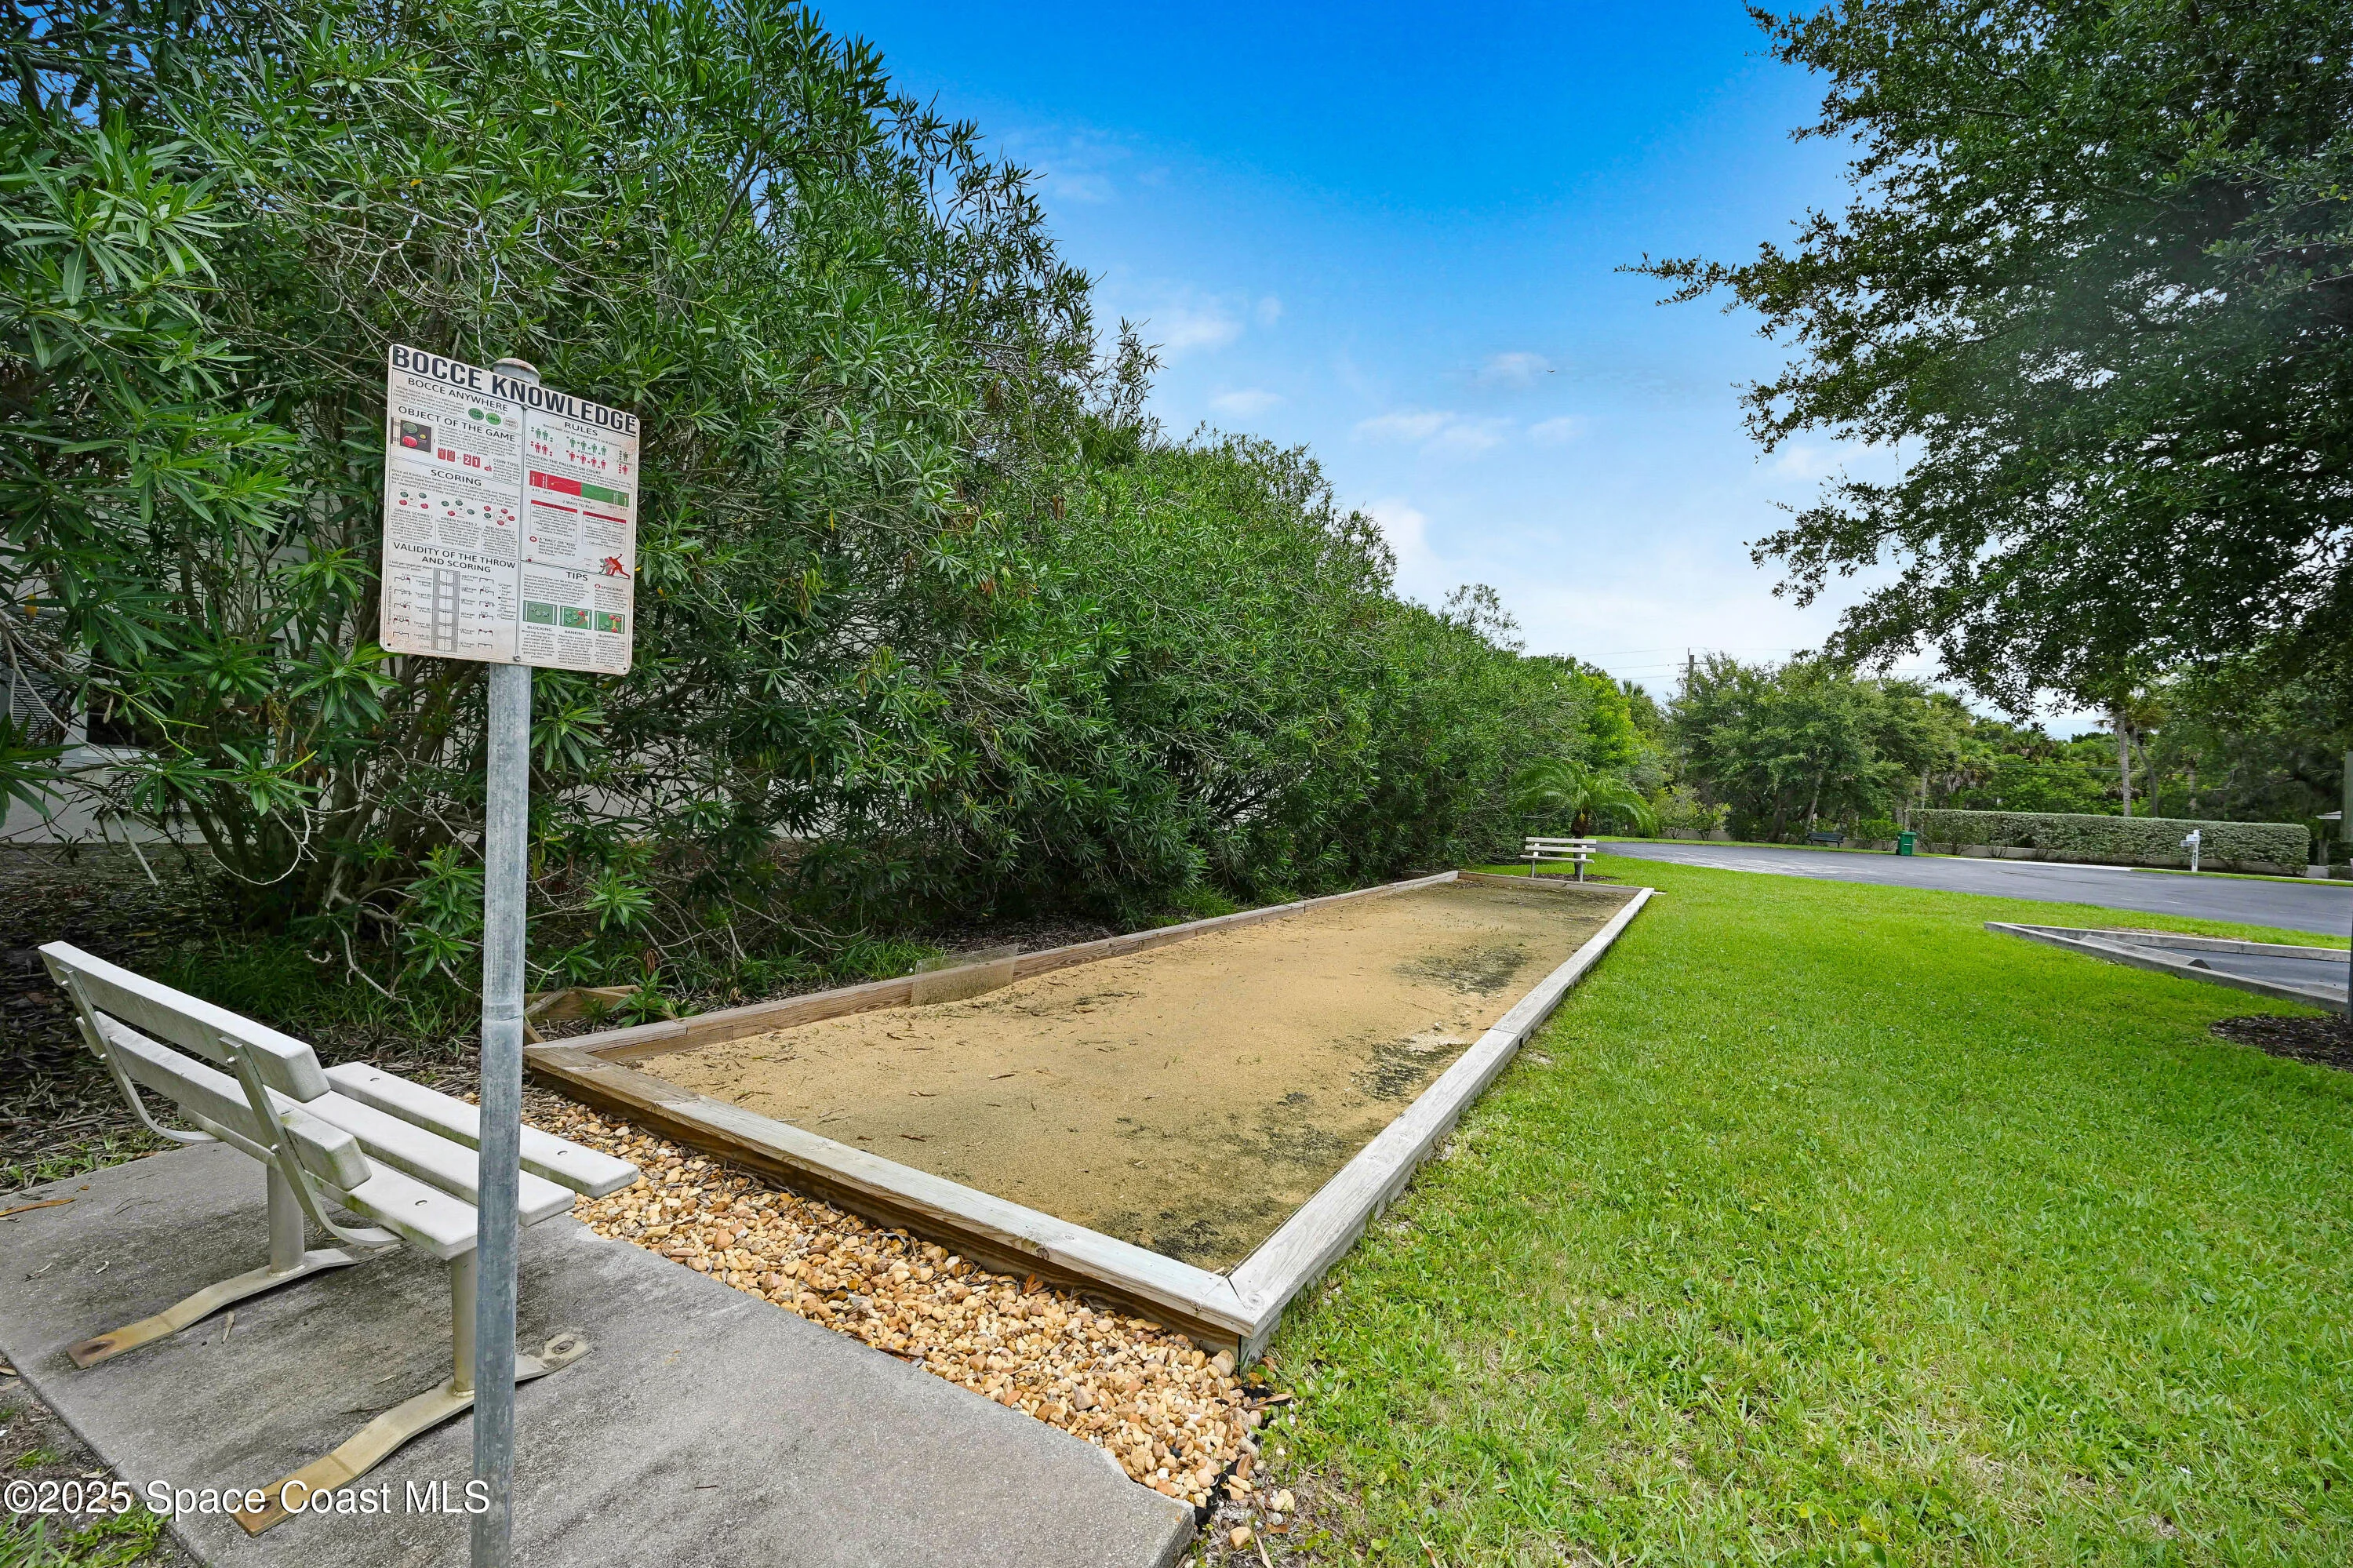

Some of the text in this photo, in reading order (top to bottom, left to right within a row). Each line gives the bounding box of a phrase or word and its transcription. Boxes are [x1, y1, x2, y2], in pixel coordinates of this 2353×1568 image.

[392, 344, 637, 435] BOCCE KNOWLEDGE
[408, 377, 508, 412] BOCCE ANYWHERE
[398, 406, 515, 442] OBJECT OF THE GAME
[565, 421, 598, 437] RULES
[526, 453, 547, 462] POSITION
[431, 468, 482, 486] SCORING
[393, 542, 515, 569] VALIDITY OF THE THROW
[422, 555, 491, 573] AND SCORING
[566, 571, 588, 581] TIPS
